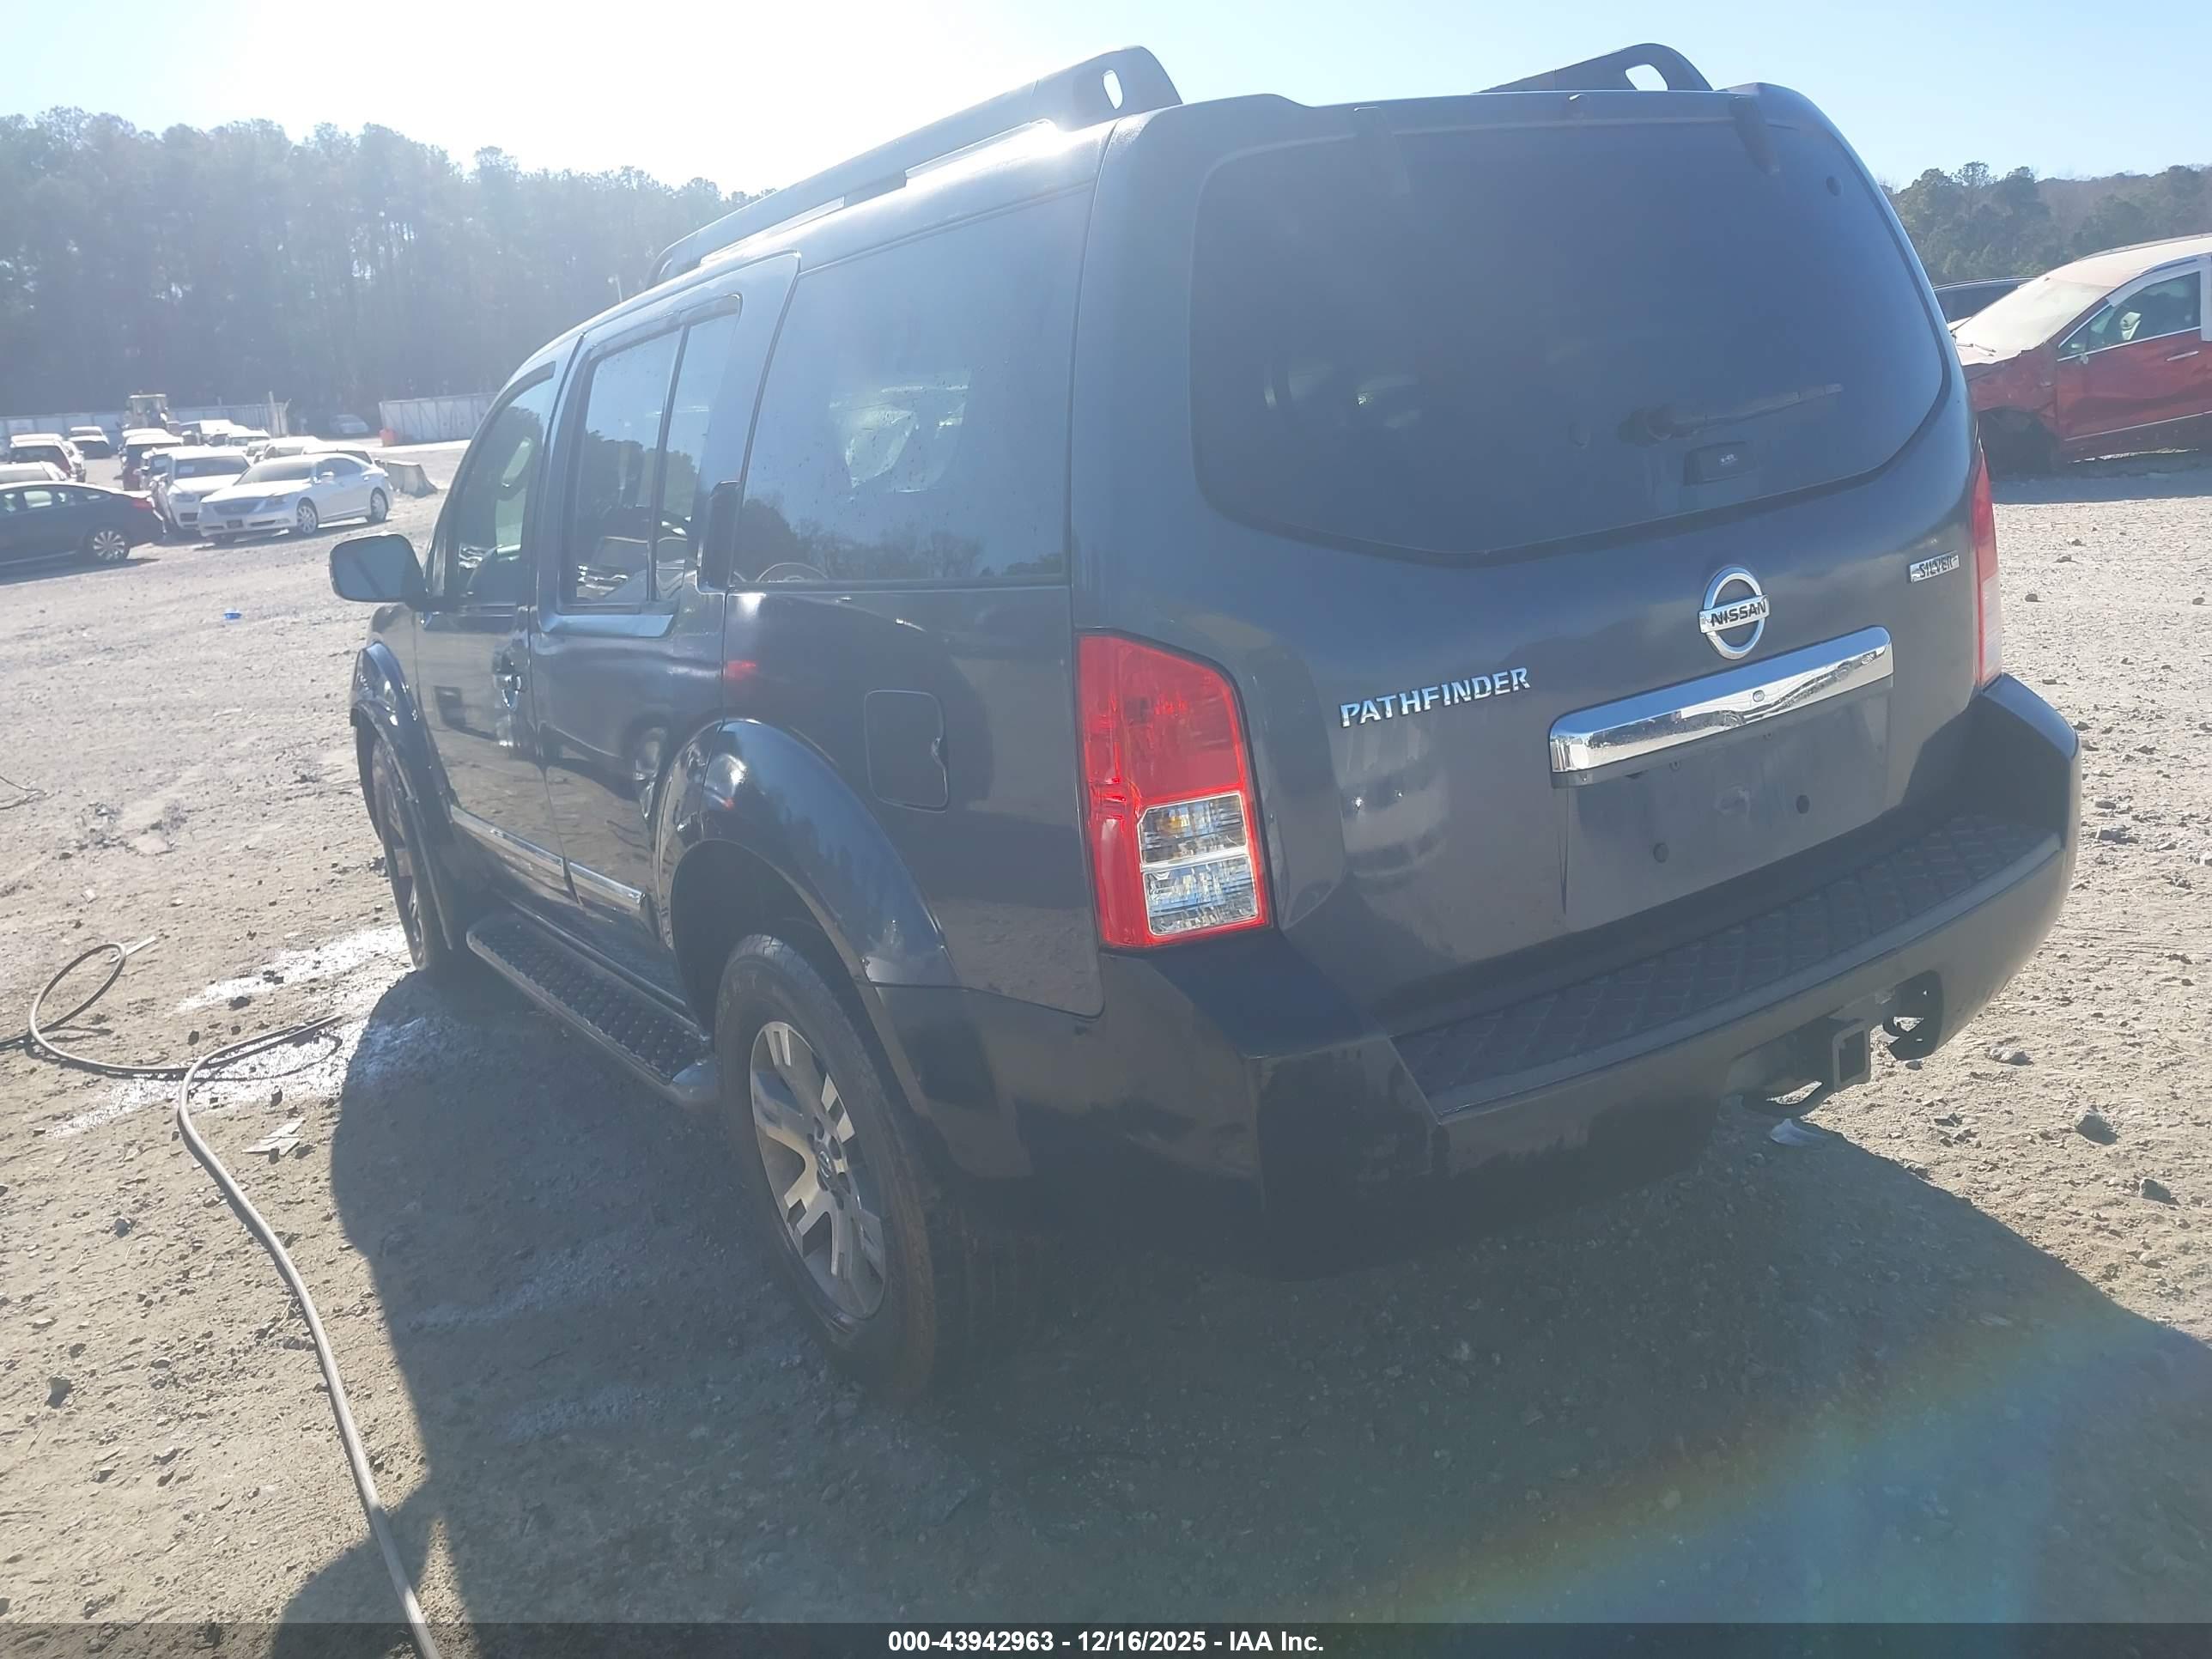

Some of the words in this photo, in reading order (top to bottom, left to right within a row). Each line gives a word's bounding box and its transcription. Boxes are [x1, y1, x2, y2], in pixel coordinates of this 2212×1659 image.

[1917, 556, 1955, 578] SILVER
[1710, 600, 1766, 627] NISSAN
[1340, 667, 1531, 727] PATHFINDER
